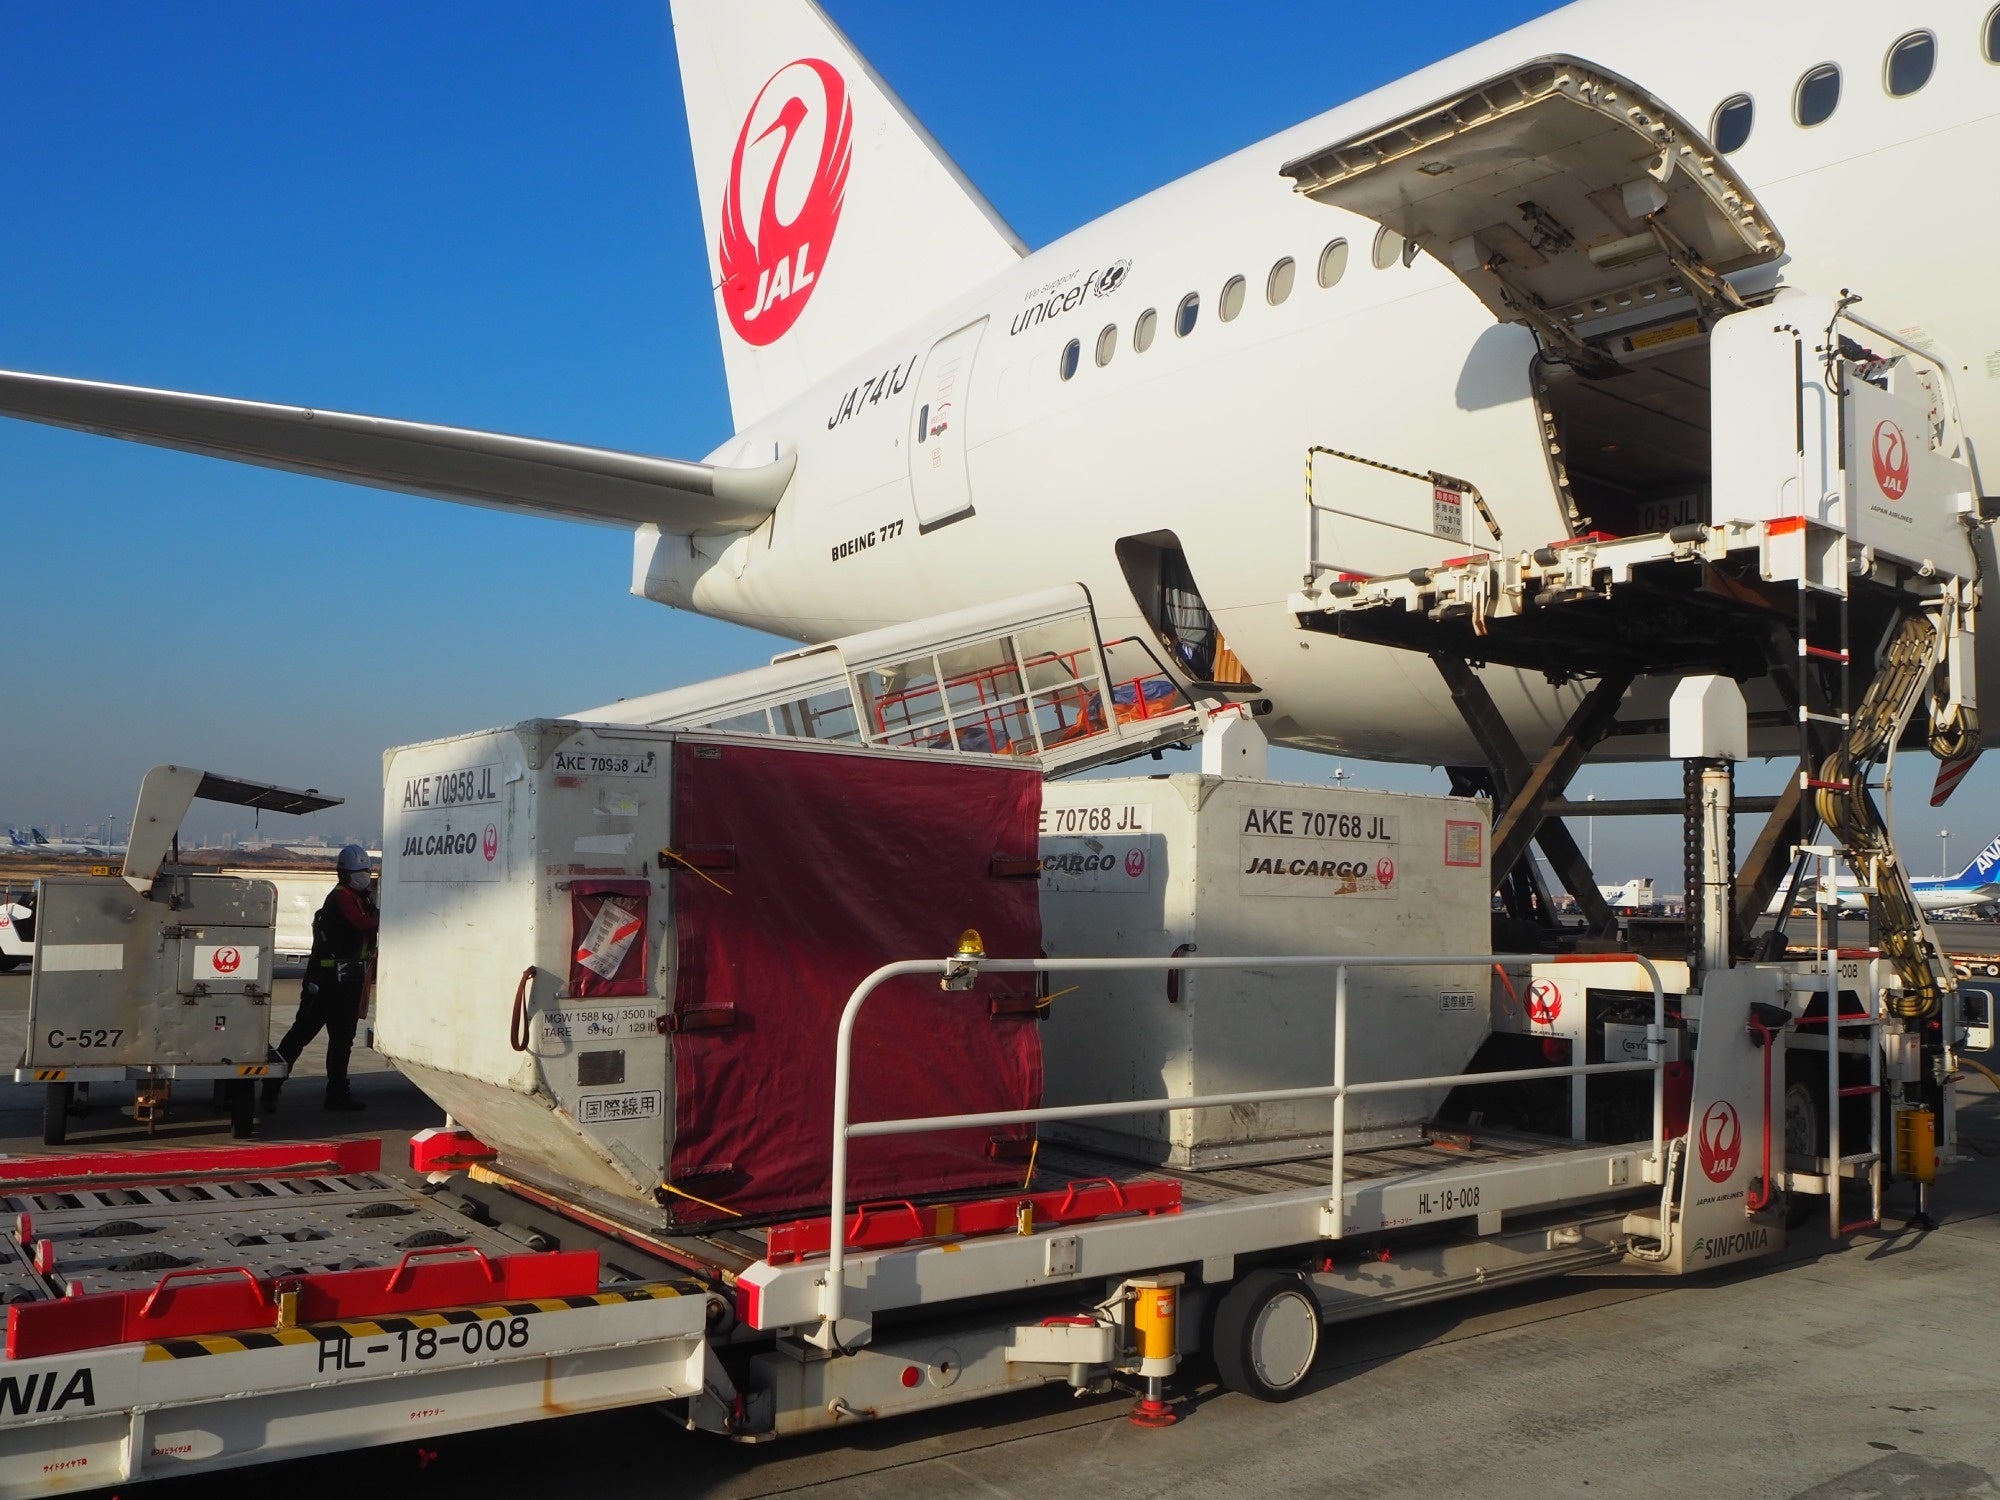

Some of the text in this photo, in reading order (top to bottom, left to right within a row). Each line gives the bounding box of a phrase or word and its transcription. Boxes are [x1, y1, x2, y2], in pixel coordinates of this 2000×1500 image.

[744, 241, 814, 321] JAL
[1024, 269, 1079, 301] We support
[1010, 270, 1099, 336] unicef
[827, 354, 917, 430] JA741J
[1883, 475, 1903, 493] JAL
[1870, 504, 1913, 524] JAPAN AIRLINES
[831, 519, 904, 561] BOEING 777
[556, 756, 585, 771] AKE
[404, 768, 496, 808] AKE 70958 JL
[1056, 807, 1111, 832] 70768
[1117, 806, 1142, 831] JL
[1244, 808, 1391, 840] AKE 70768 JL
[1042, 854, 1116, 871] CARGO
[545, 1013, 572, 1023] MGW
[576, 1011, 599, 1022] 1588
[602, 1012, 613, 1023] kg
[622, 1009, 645, 1020] 3500
[648, 1008, 656, 1019] lb
[1533, 1010, 1555, 1020] JAL
[48, 1029, 123, 1048] C-527
[544, 1027, 572, 1038] TARE
[602, 1025, 613, 1036] kg
[630, 1023, 645, 1033] 129
[648, 1022, 656, 1032] lb
[586, 1096, 654, 1119] 国際線用
[1711, 1158, 1733, 1174] JAL
[1419, 1187, 1480, 1214] HL-18-008
[1696, 1191, 1744, 1206] JAPAN AIRLINES
[1705, 1229, 1768, 1260] SINFONIA
[318, 1317, 530, 1373] HL-18-008
[0, 1368, 95, 1416] NIA
[410, 1408, 446, 1419] タイヤフリー
